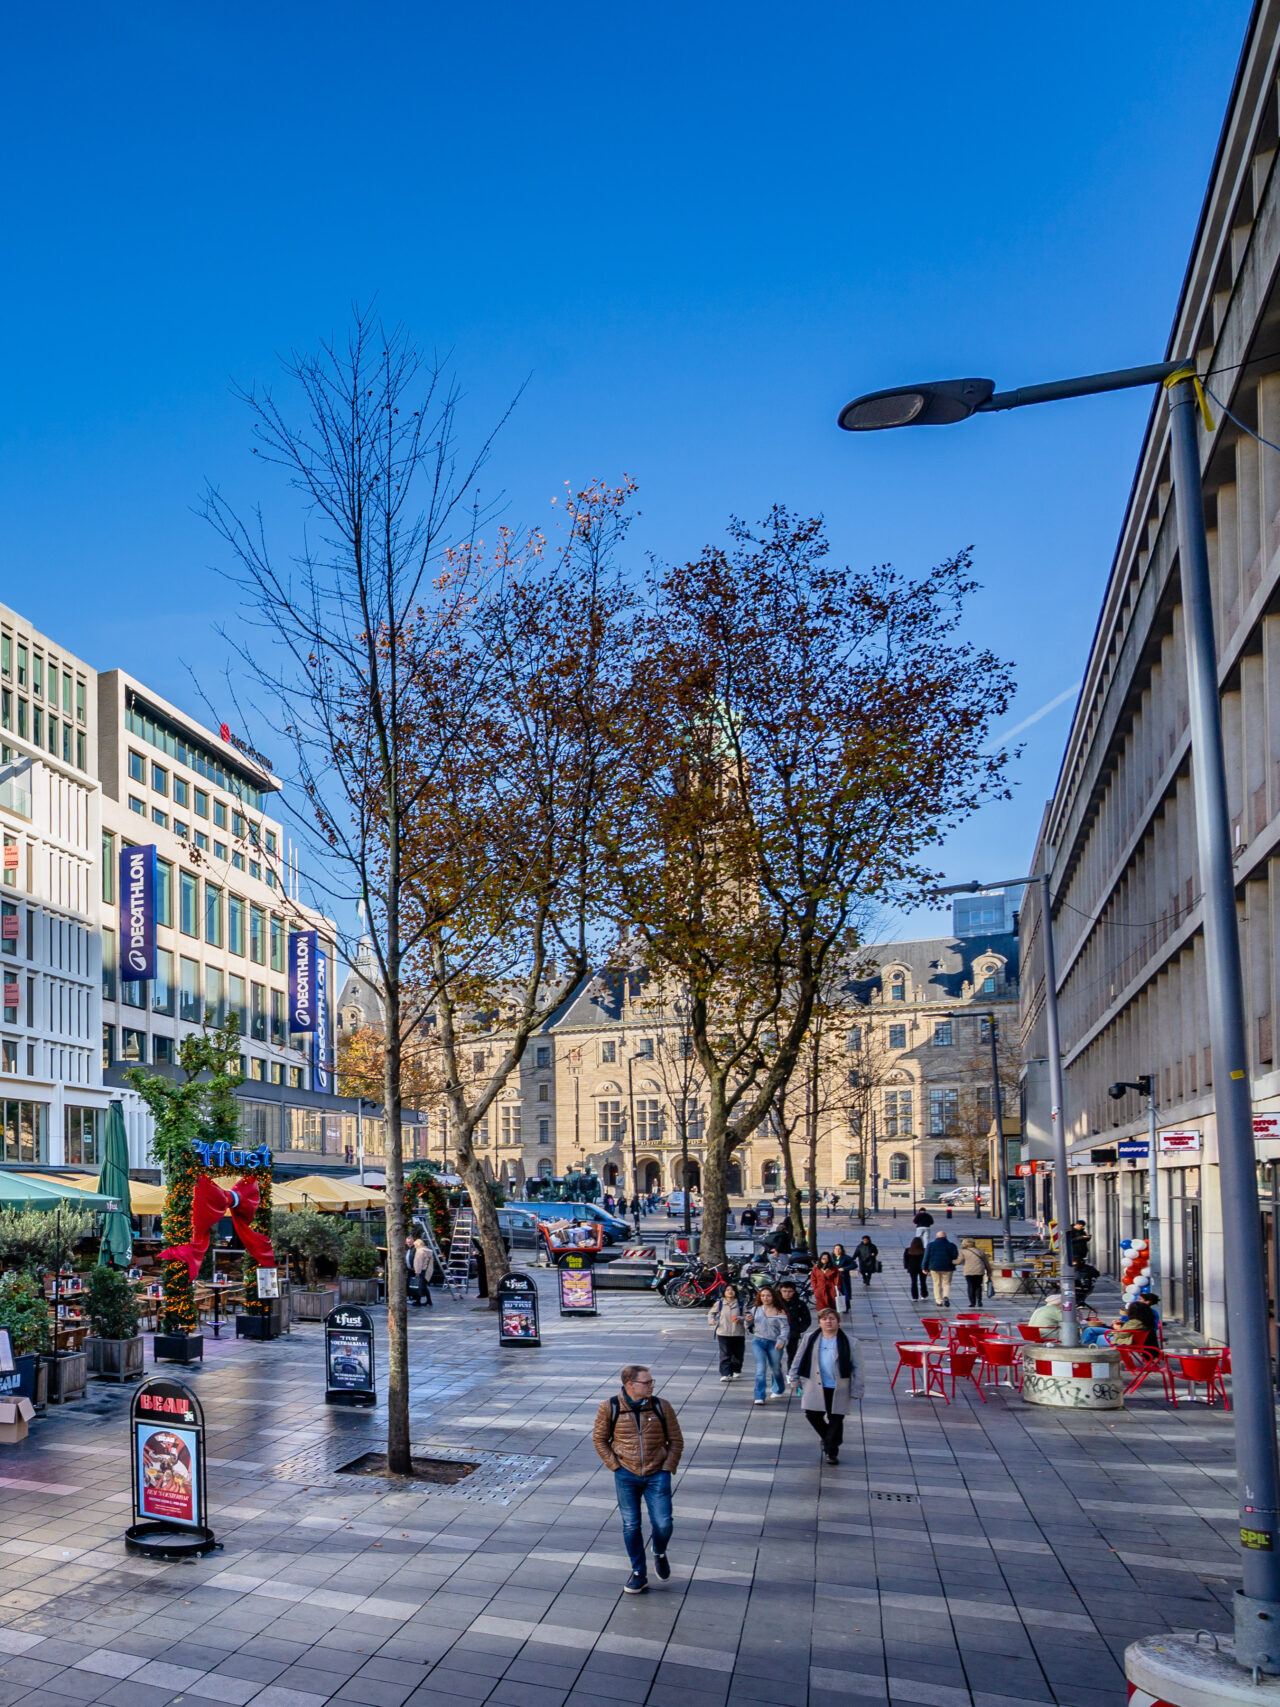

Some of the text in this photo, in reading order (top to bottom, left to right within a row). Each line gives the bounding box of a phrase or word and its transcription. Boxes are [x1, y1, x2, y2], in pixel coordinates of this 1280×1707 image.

[130, 853, 144, 947] DECATHLON
[297, 936, 309, 1008] DECATHLON
[317, 958, 326, 1062] DECATHLON
[140, 1394, 189, 1414] BEAU
